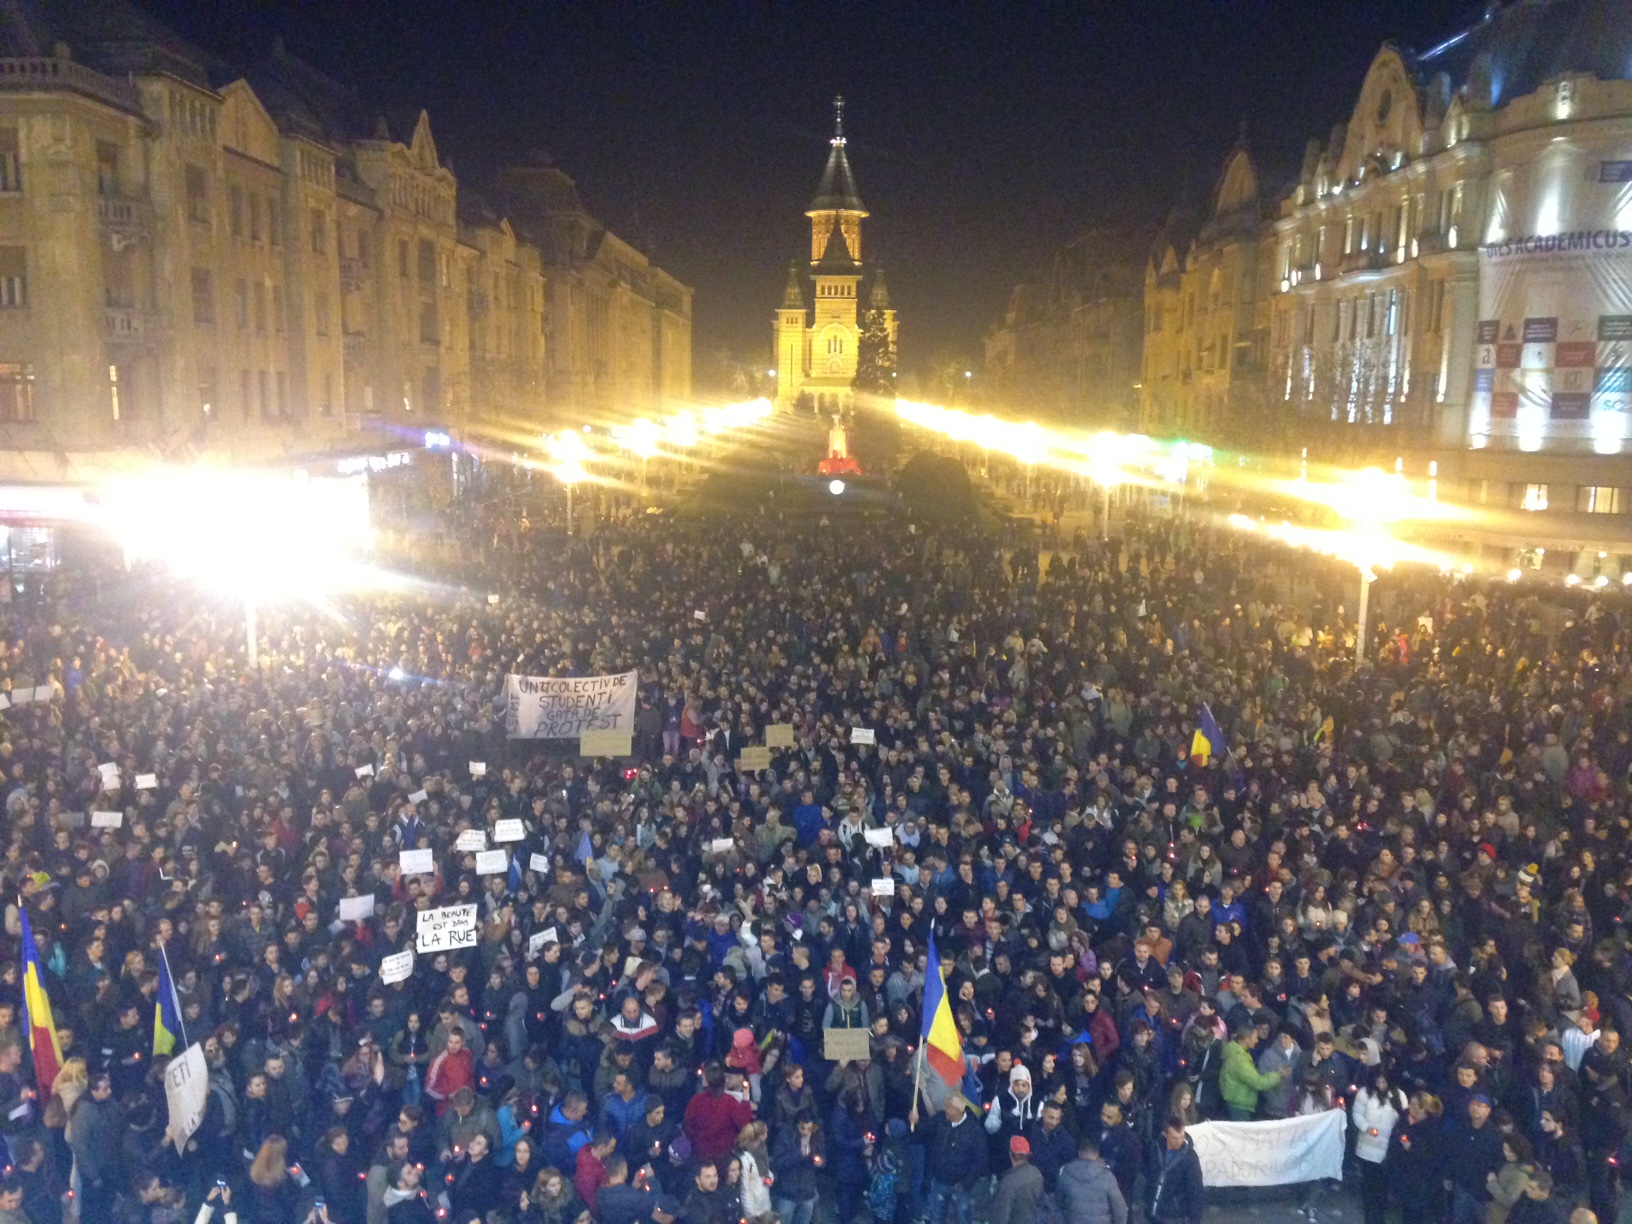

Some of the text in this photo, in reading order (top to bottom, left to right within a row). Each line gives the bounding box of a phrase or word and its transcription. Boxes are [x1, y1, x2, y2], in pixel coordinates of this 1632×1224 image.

[1514, 229, 1632, 255] ACADEMICUS
[519, 679, 537, 694] UN
[612, 675, 627, 687] DE
[534, 713, 622, 738] PROTEST
[422, 913, 434, 923] LA
[433, 919, 469, 930] EST DANS
[422, 929, 475, 947] LA RUE
